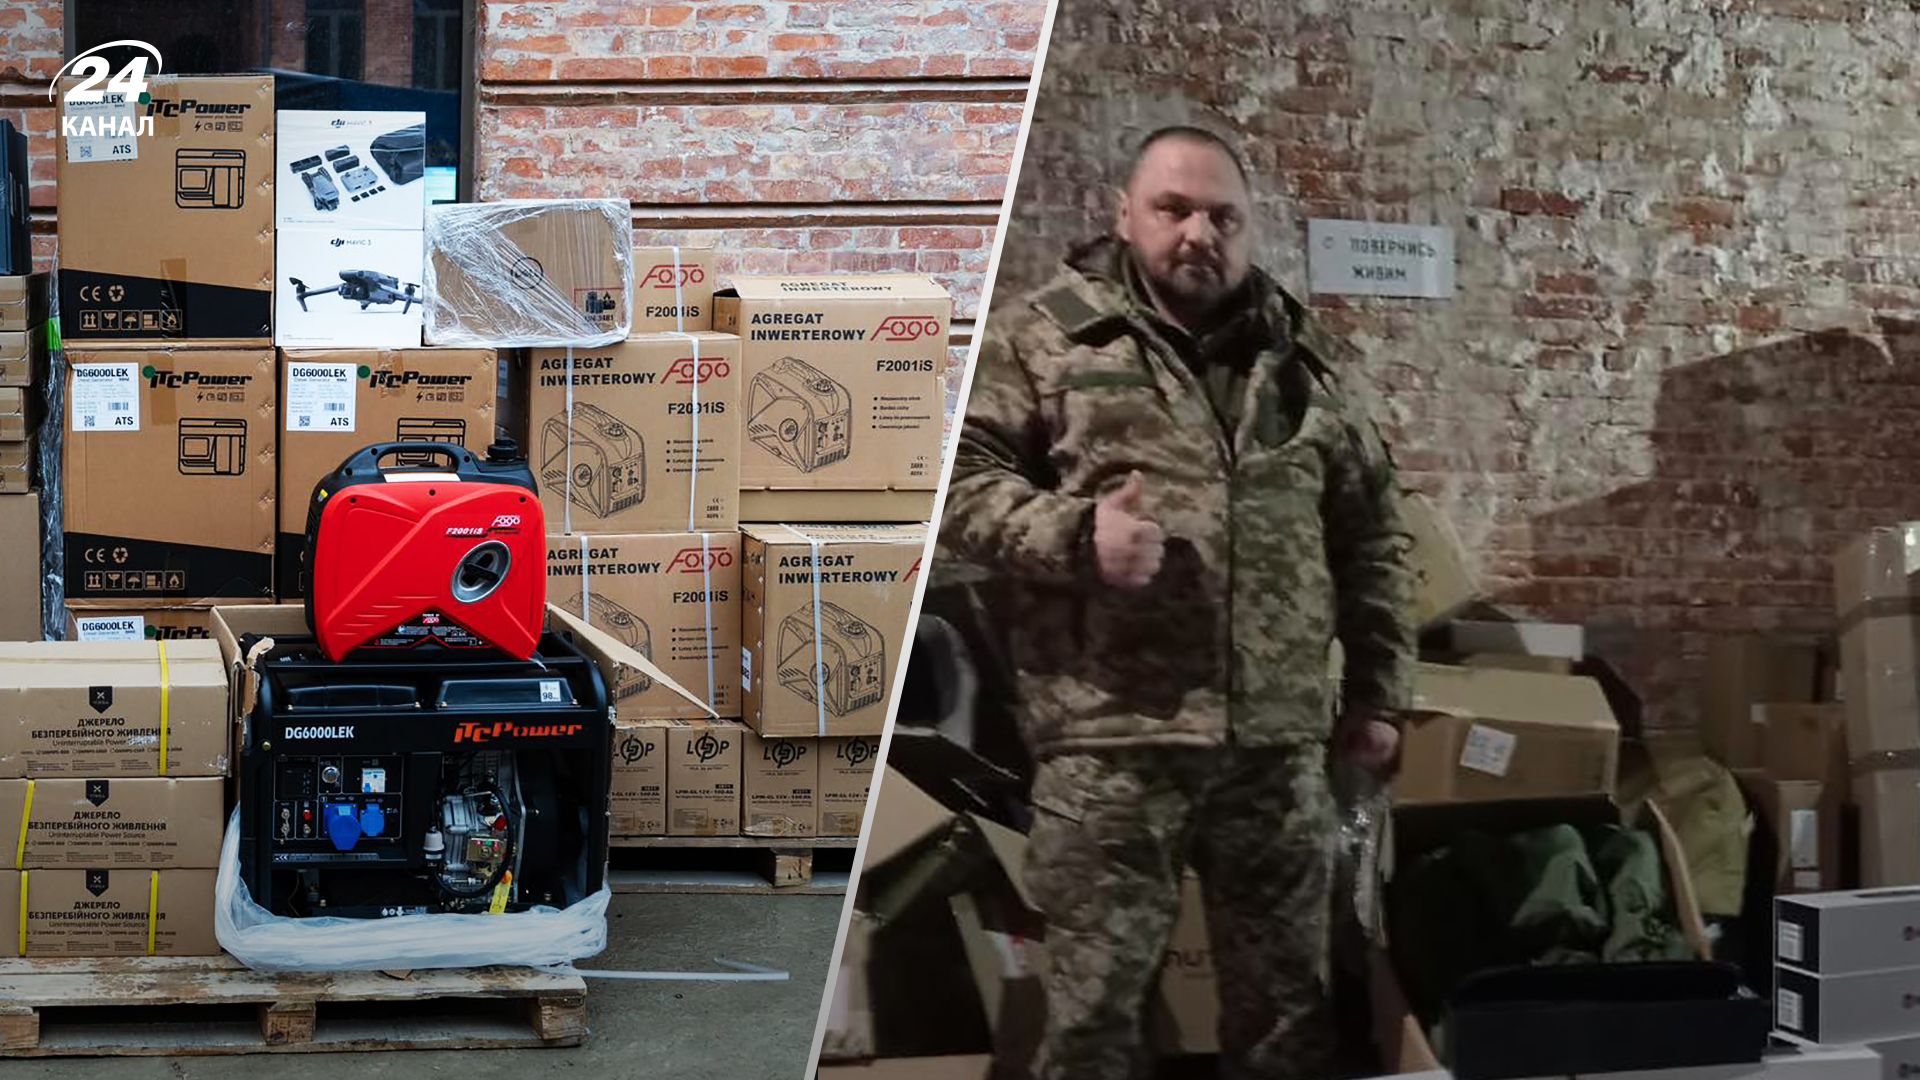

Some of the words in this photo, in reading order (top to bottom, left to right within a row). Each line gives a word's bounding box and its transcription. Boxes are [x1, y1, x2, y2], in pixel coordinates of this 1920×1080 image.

[112, 145, 131, 154] ATS
[1350, 238, 1436, 258] ПОВЕРНИСЬ
[1352, 265, 1407, 281] ЖИВИМ
[751, 313, 824, 324] AGREGAT
[751, 329, 866, 341] INWERTEROWY
[876, 360, 933, 372] F2001iS
[76, 368, 129, 378] DG6000LEK
[293, 368, 346, 377] DG6000LEK
[540, 373, 656, 386] INWERTEROWY
[115, 416, 133, 425] ATS
[330, 417, 349, 426] ATS
[547, 562, 661, 576] INWERTEROWY
[672, 591, 729, 603] F2001iS
[82, 621, 134, 631] DG6000LEK
[542, 692, 554, 700] 98
[77, 718, 125, 728] ДЖЕРЕЛО
[31, 728, 115, 739] БЕЗПЕРЕБІЙНОГО
[116, 726, 171, 738] ЖИВЛЕНЯ
[284, 726, 355, 739] DG6000LEK
[105, 738, 127, 746] Power
[73, 811, 121, 821] ДЖЕРЕЛО
[28, 820, 111, 831] БЕЗПЕРЕБІЙНОГО
[112, 822, 167, 831] ЖИВЛЕННЯ
[100, 831, 122, 840] Power
[123, 831, 146, 839] Source
[73, 901, 121, 910] ДЖЕРЕЛО
[28, 910, 111, 921] БЕЗПЕРЕБІЙНОГО
